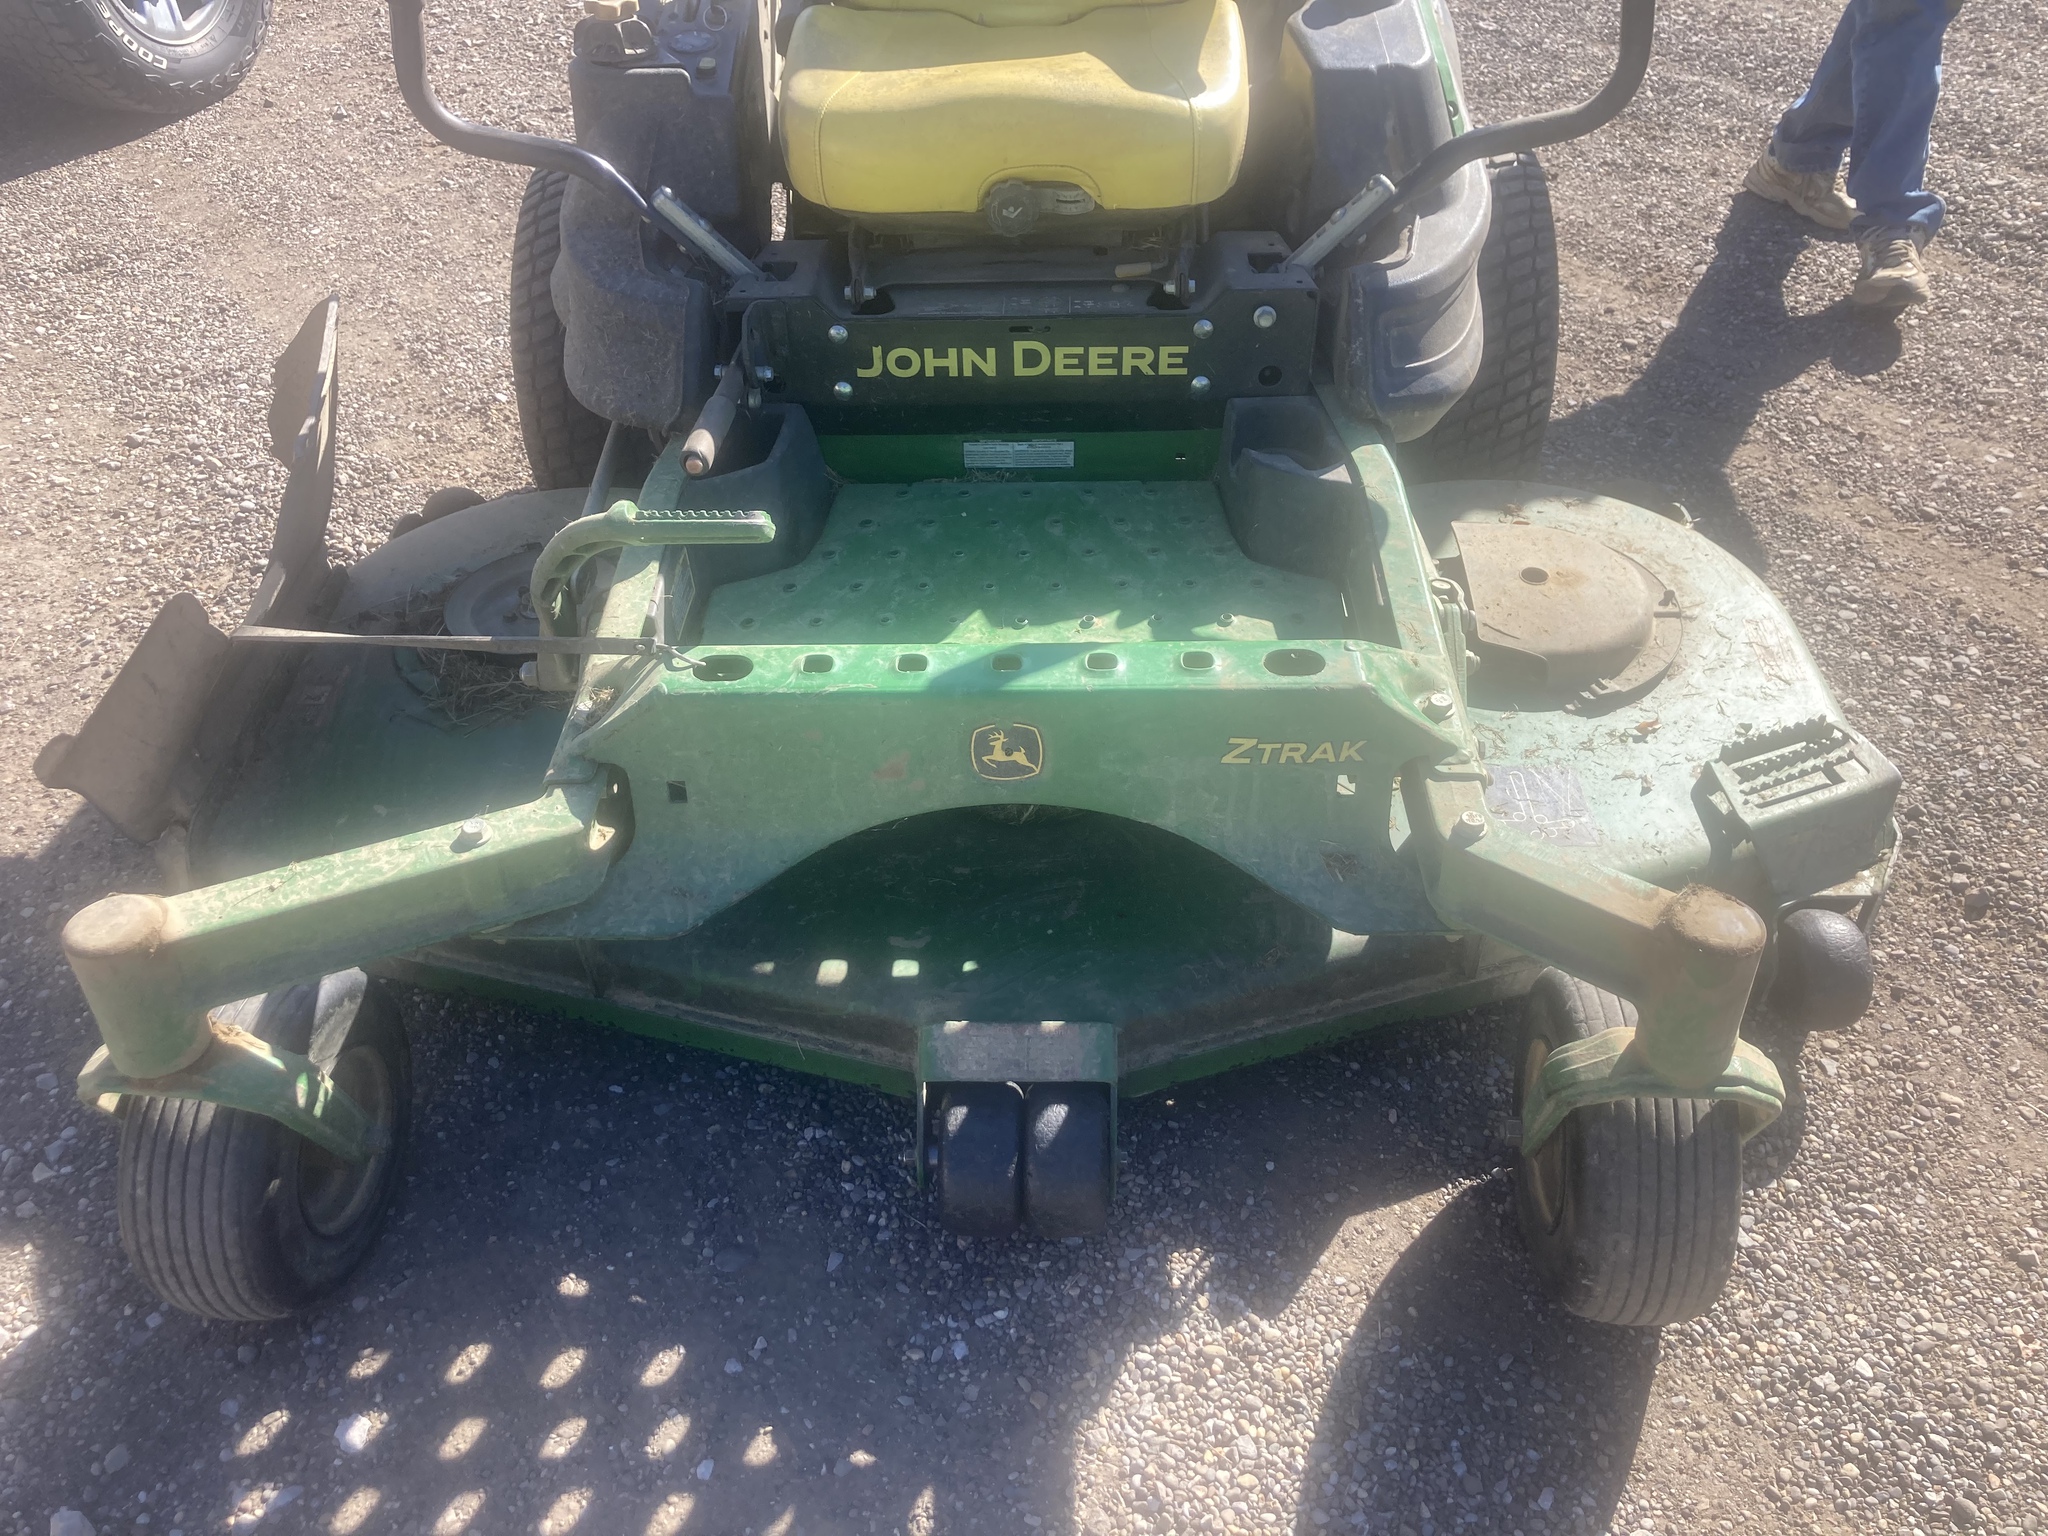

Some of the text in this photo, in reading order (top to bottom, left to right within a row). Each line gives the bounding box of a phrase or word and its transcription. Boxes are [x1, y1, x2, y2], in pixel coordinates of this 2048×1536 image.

[856, 339, 1190, 379] JOHN DEERE
[1220, 737, 1368, 765] ZTRAK
